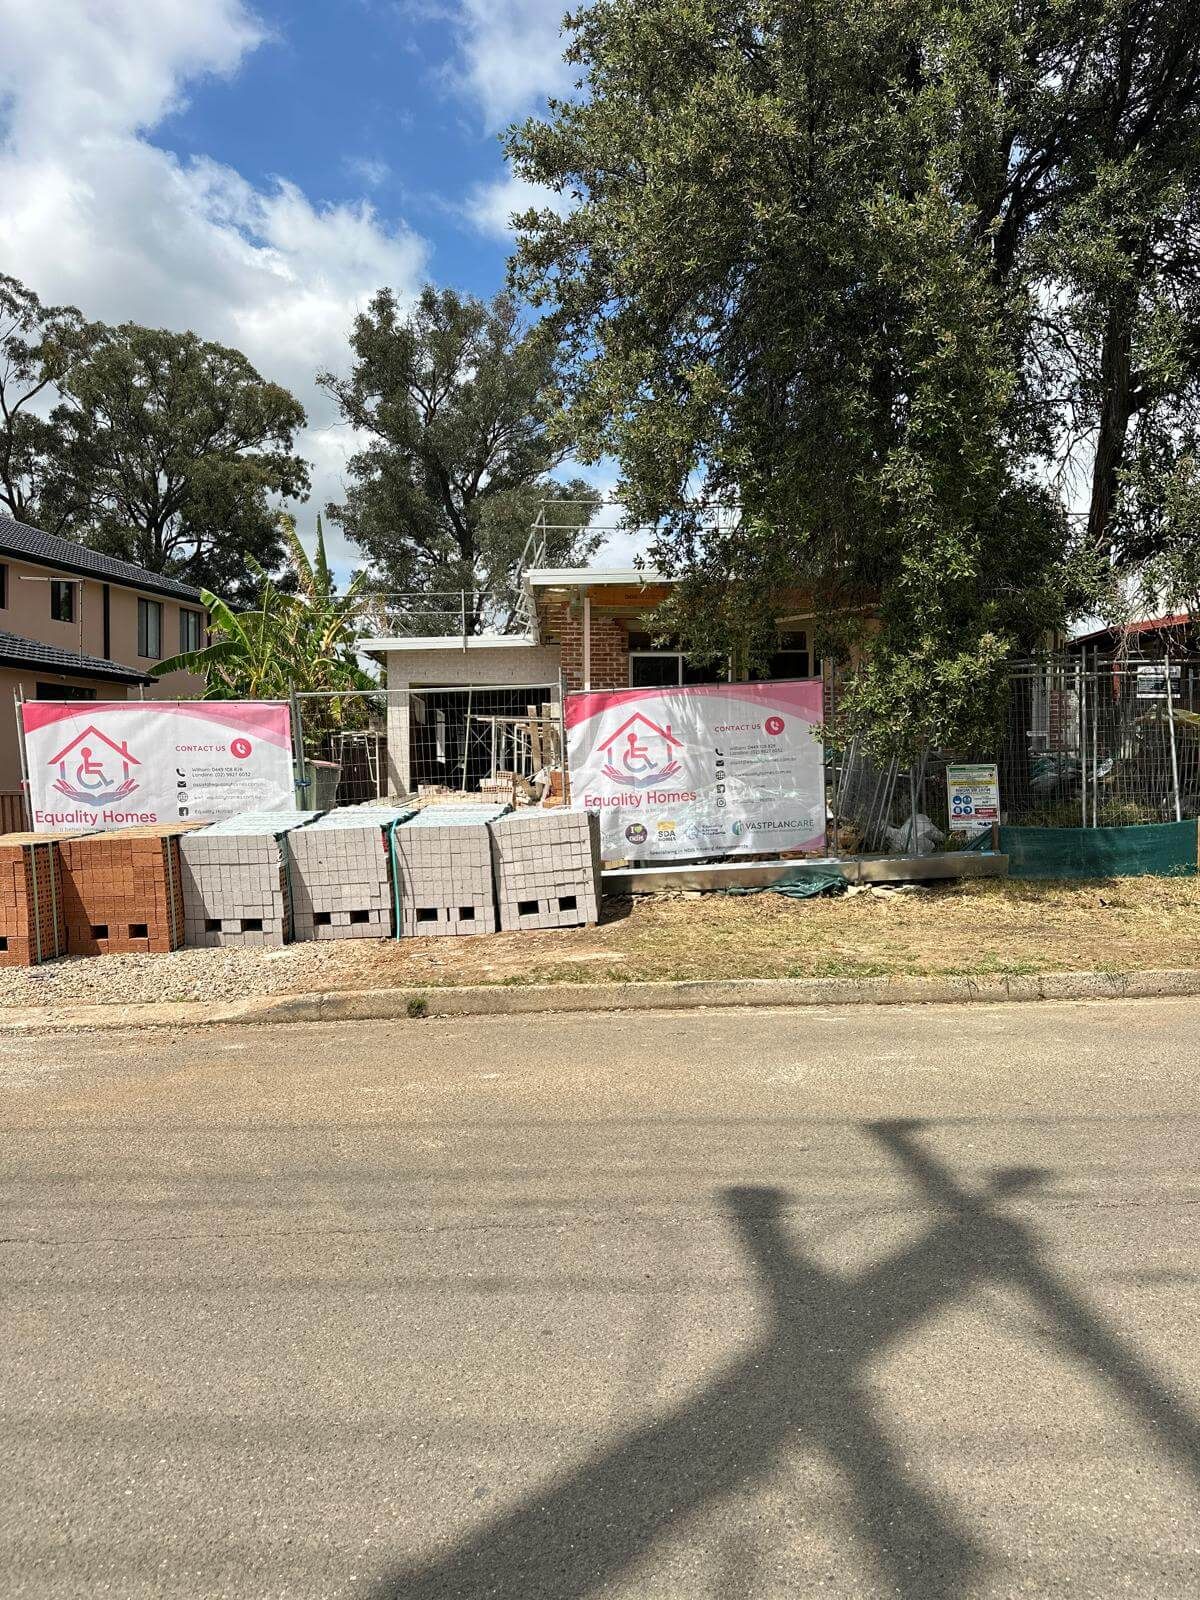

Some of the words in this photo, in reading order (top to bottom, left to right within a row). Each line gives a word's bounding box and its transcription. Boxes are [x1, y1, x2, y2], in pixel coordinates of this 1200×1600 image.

[714, 724, 750, 732] CONTACT
[584, 792, 642, 808] Equality
[647, 790, 697, 804] Homes
[35, 809, 98, 826] Equality
[103, 810, 157, 823] Homes
[745, 819, 814, 830] VASTPLANCARE
[658, 830, 676, 838] SDA
